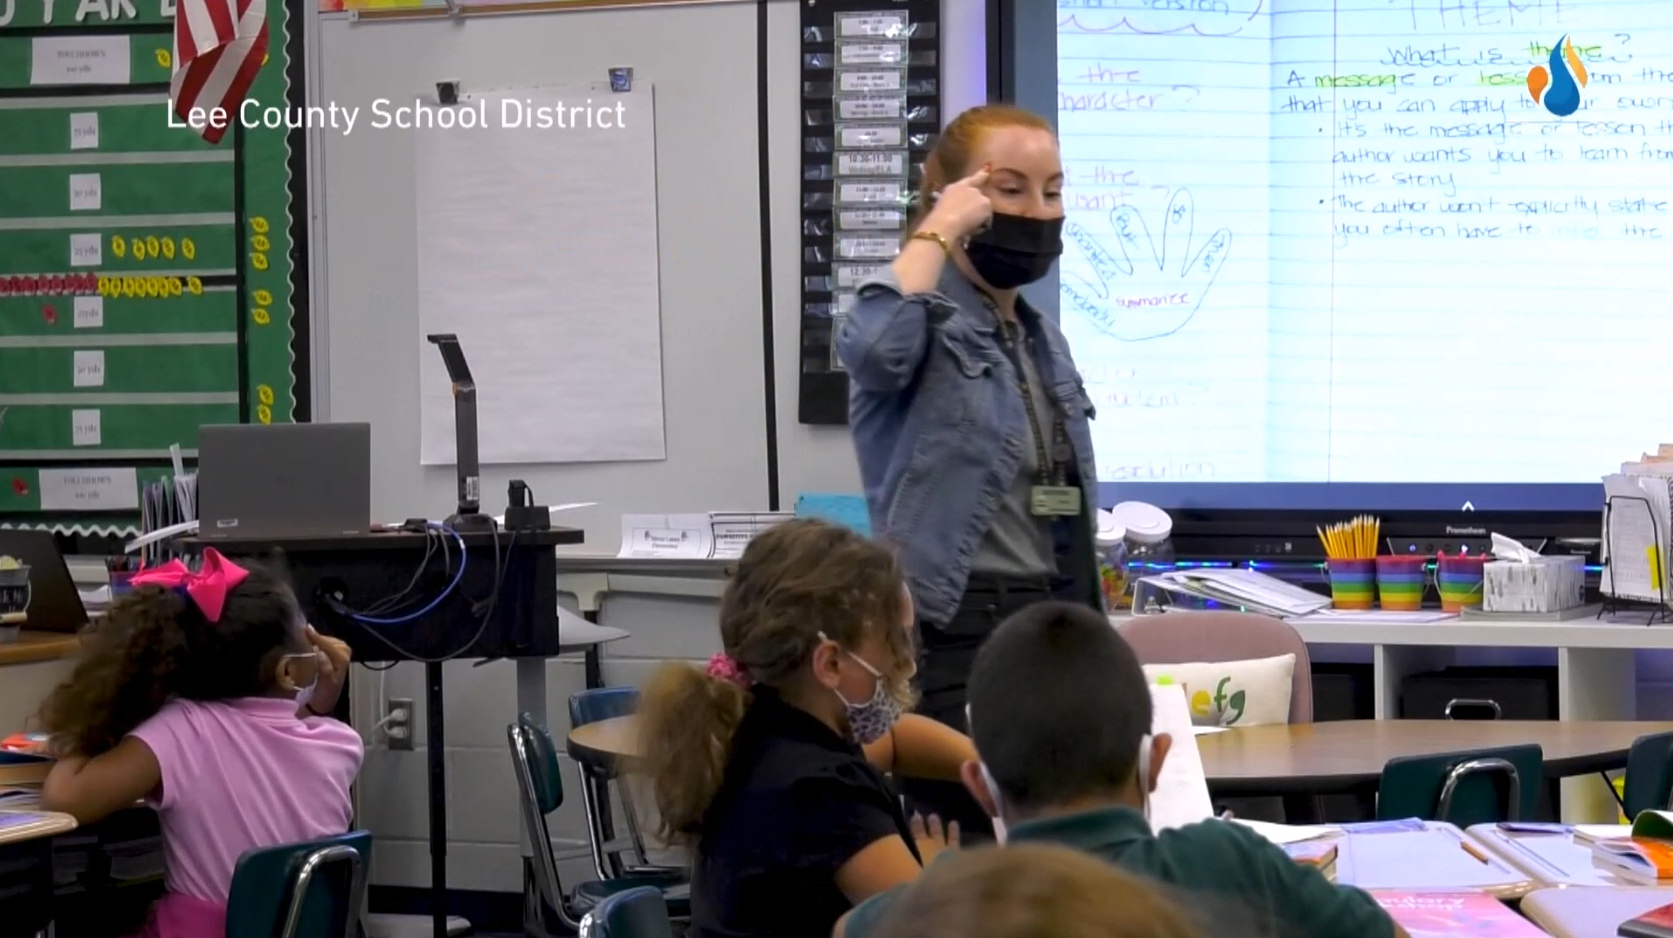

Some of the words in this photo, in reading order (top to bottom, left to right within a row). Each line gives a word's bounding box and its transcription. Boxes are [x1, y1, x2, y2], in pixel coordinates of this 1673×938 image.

[1387, 42, 1460, 62] What
[1480, 48, 1503, 60] is
[1075, 63, 1141, 82] the
[1287, 69, 1306, 88] A
[1315, 73, 1416, 95] message
[1433, 74, 1458, 87] or
[1280, 95, 1332, 113] that
[1343, 98, 1382, 120] you
[1396, 98, 1436, 113] can
[1449, 95, 1506, 122] apply
[1381, 121, 1419, 138] the
[1430, 121, 1522, 146] message
[1541, 124, 1560, 137] or
[1576, 119, 1647, 137] lesson
[1332, 147, 1396, 163] author
[1403, 146, 1472, 163] wants
[1488, 150, 1527, 175] you
[1535, 143, 1564, 162] to
[1338, 171, 1380, 188] the
[1390, 171, 1457, 198] story
[1330, 194, 1365, 213] The
[1371, 199, 1429, 214] author
[1608, 197, 1669, 214] state
[1334, 222, 1370, 248] you
[1382, 219, 1446, 238] often
[1456, 221, 1503, 240] have
[1511, 221, 1541, 236] to
[1619, 221, 1665, 239] the
[1446, 526, 1487, 535] Promethean
